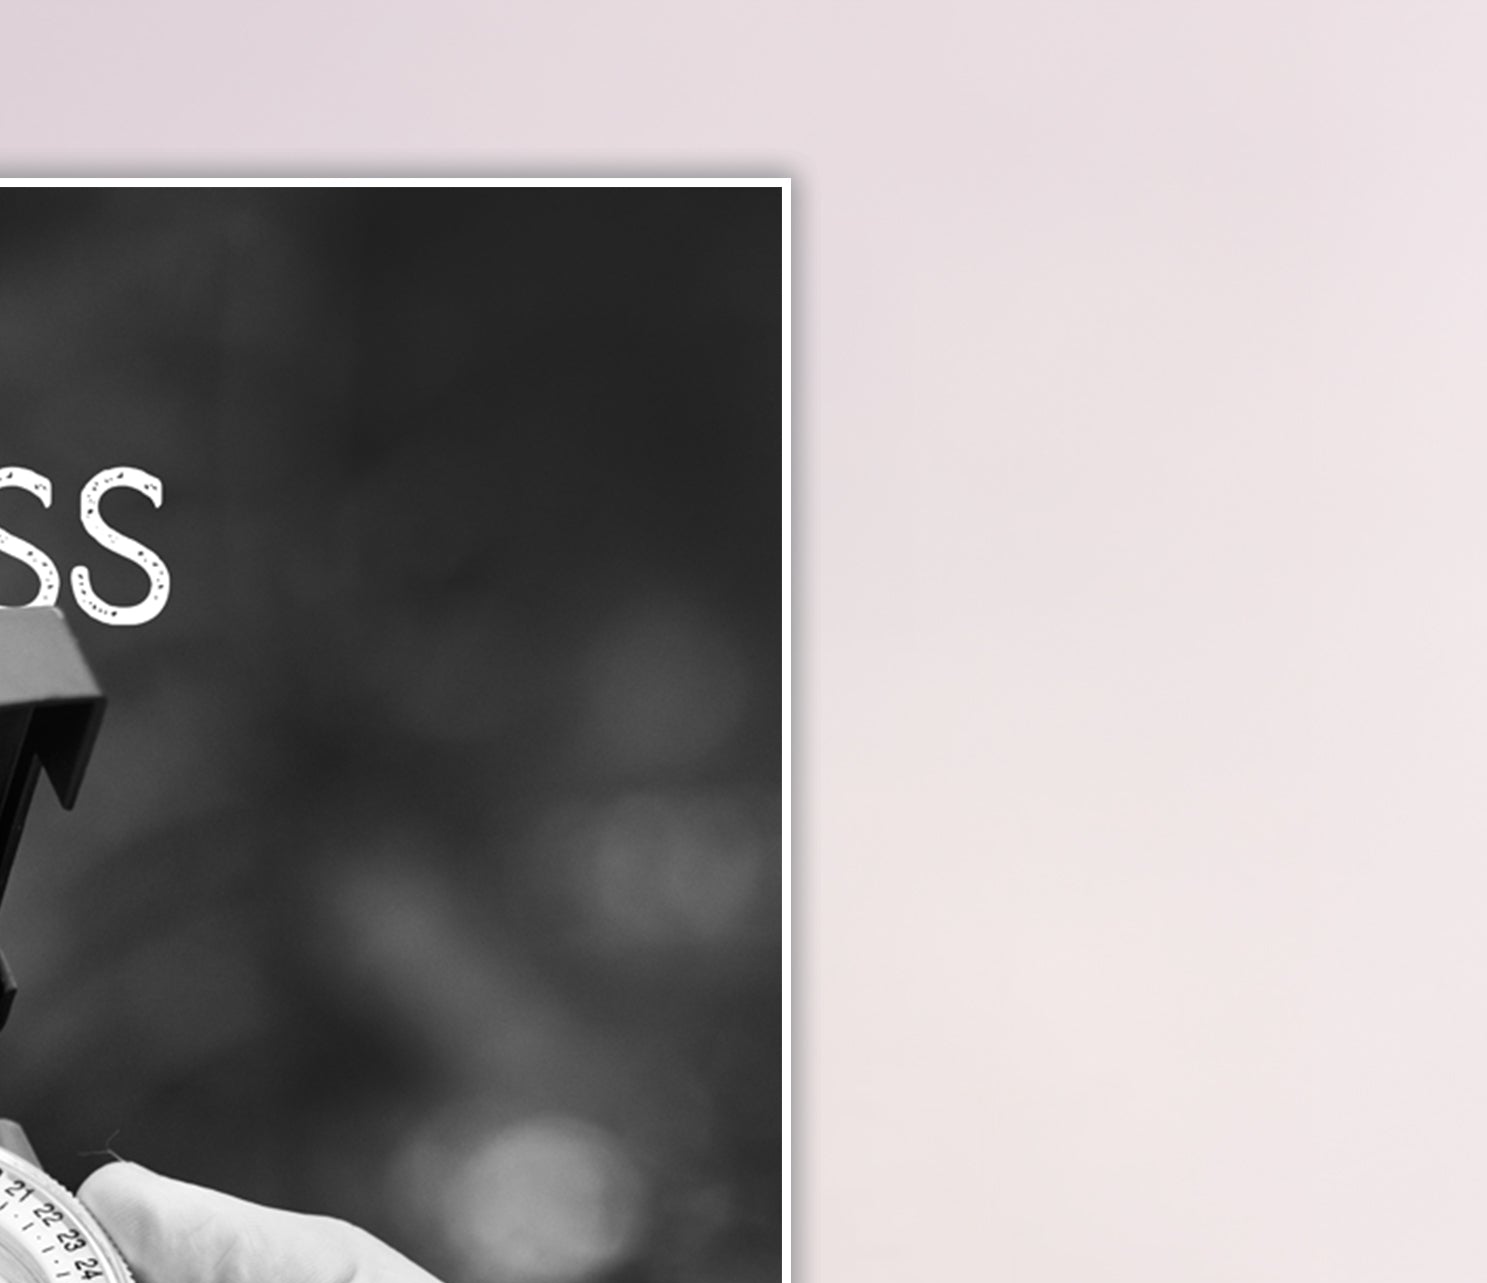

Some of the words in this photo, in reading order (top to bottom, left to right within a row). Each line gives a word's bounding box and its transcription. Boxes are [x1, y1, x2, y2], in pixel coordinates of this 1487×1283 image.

[4, 1179, 36, 1203] 21
[33, 1202, 64, 1227] 22
[56, 1228, 87, 1253] 23
[74, 1257, 104, 1281] 24
